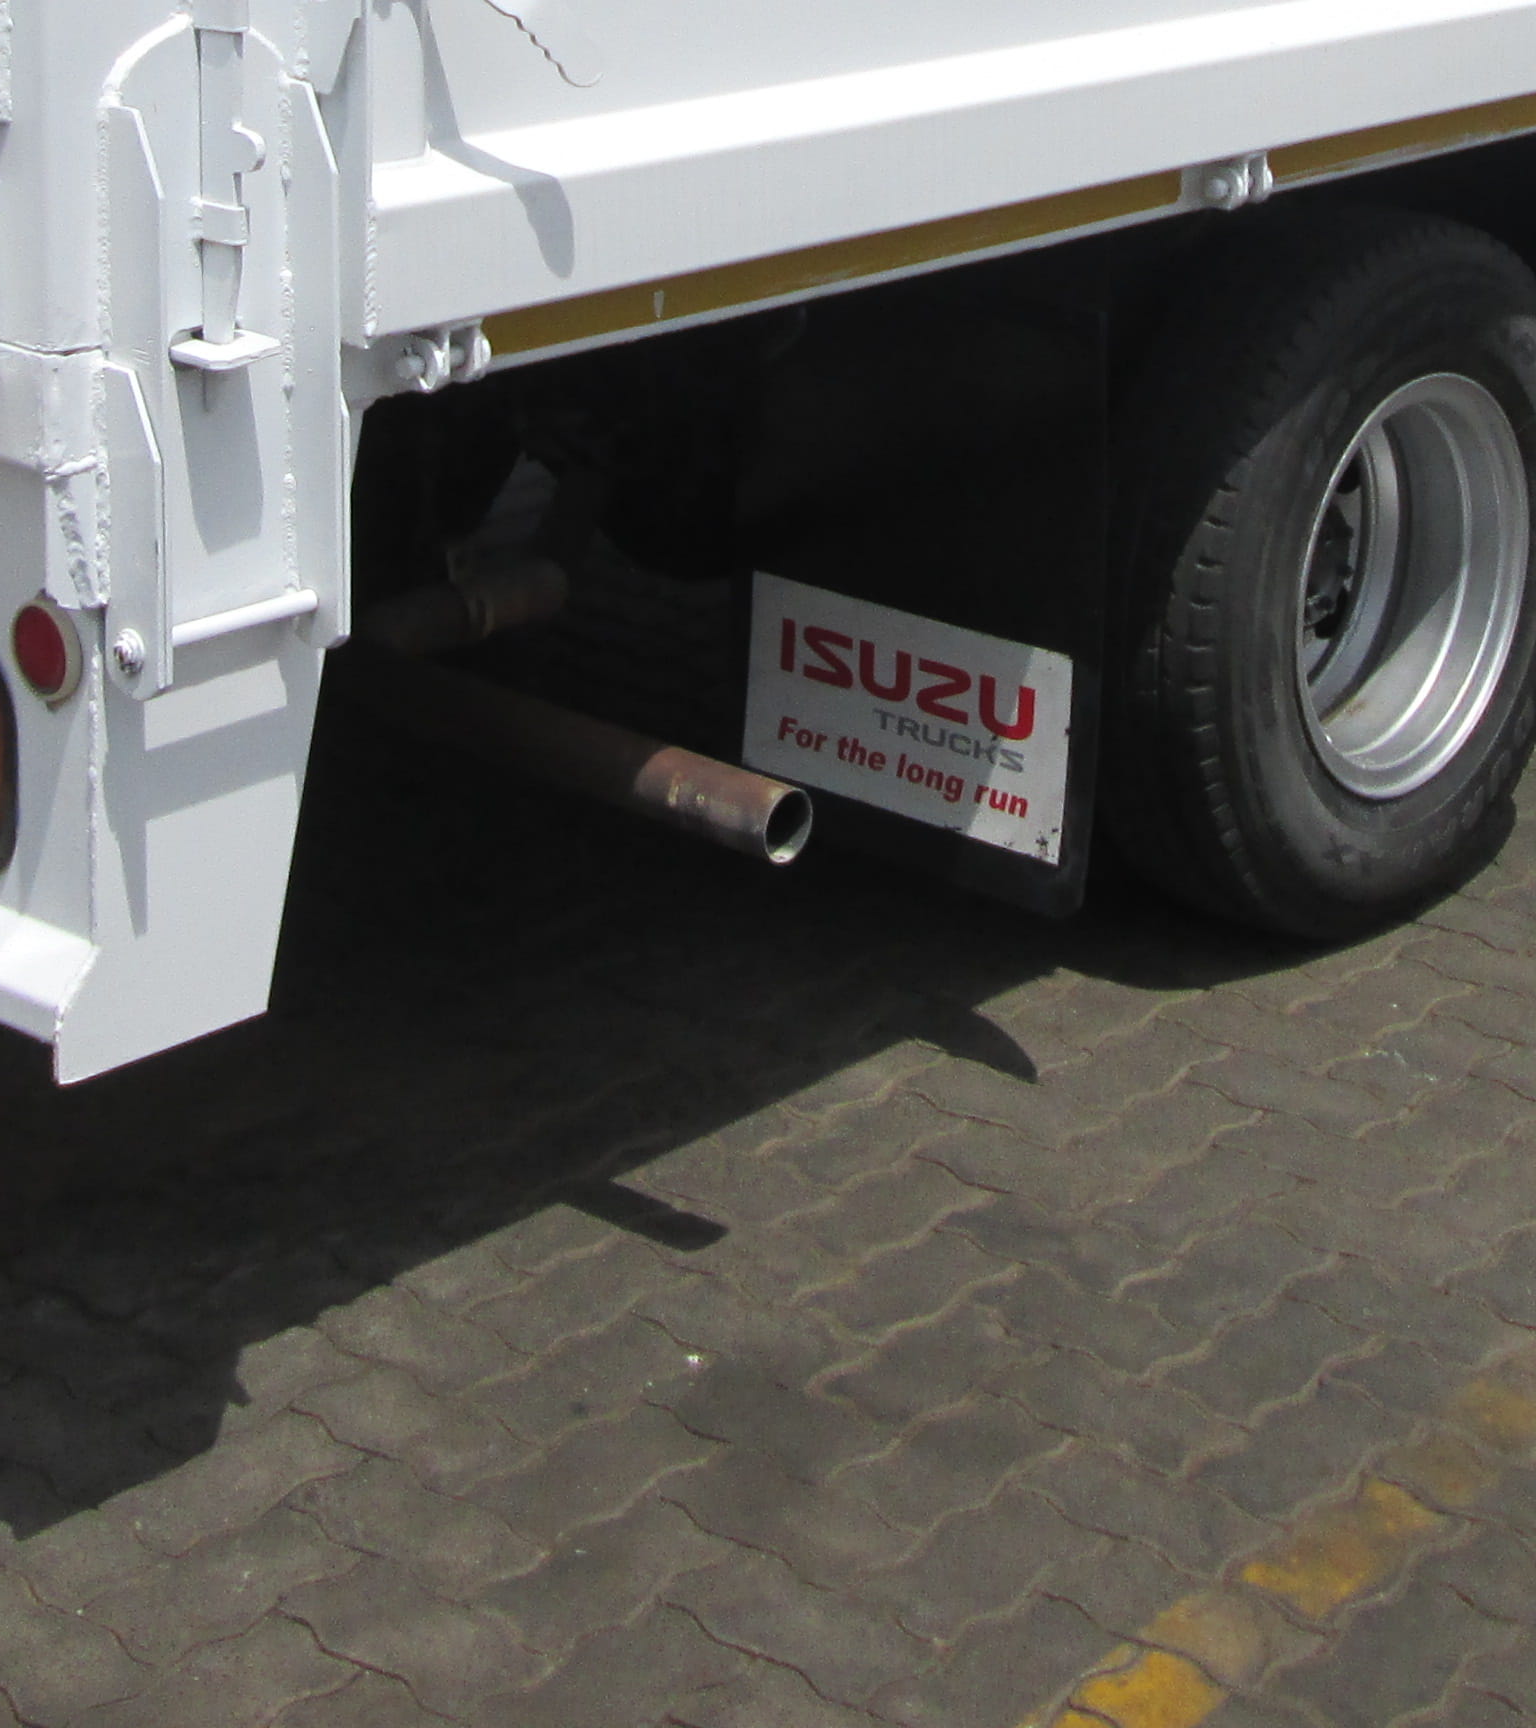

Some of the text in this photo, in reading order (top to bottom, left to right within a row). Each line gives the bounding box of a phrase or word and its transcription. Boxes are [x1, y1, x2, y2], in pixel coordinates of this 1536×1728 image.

[780, 617, 1036, 741] ISUZU
[777, 715, 1029, 819] For the long run
[872, 707, 1025, 774] TRUCKS
